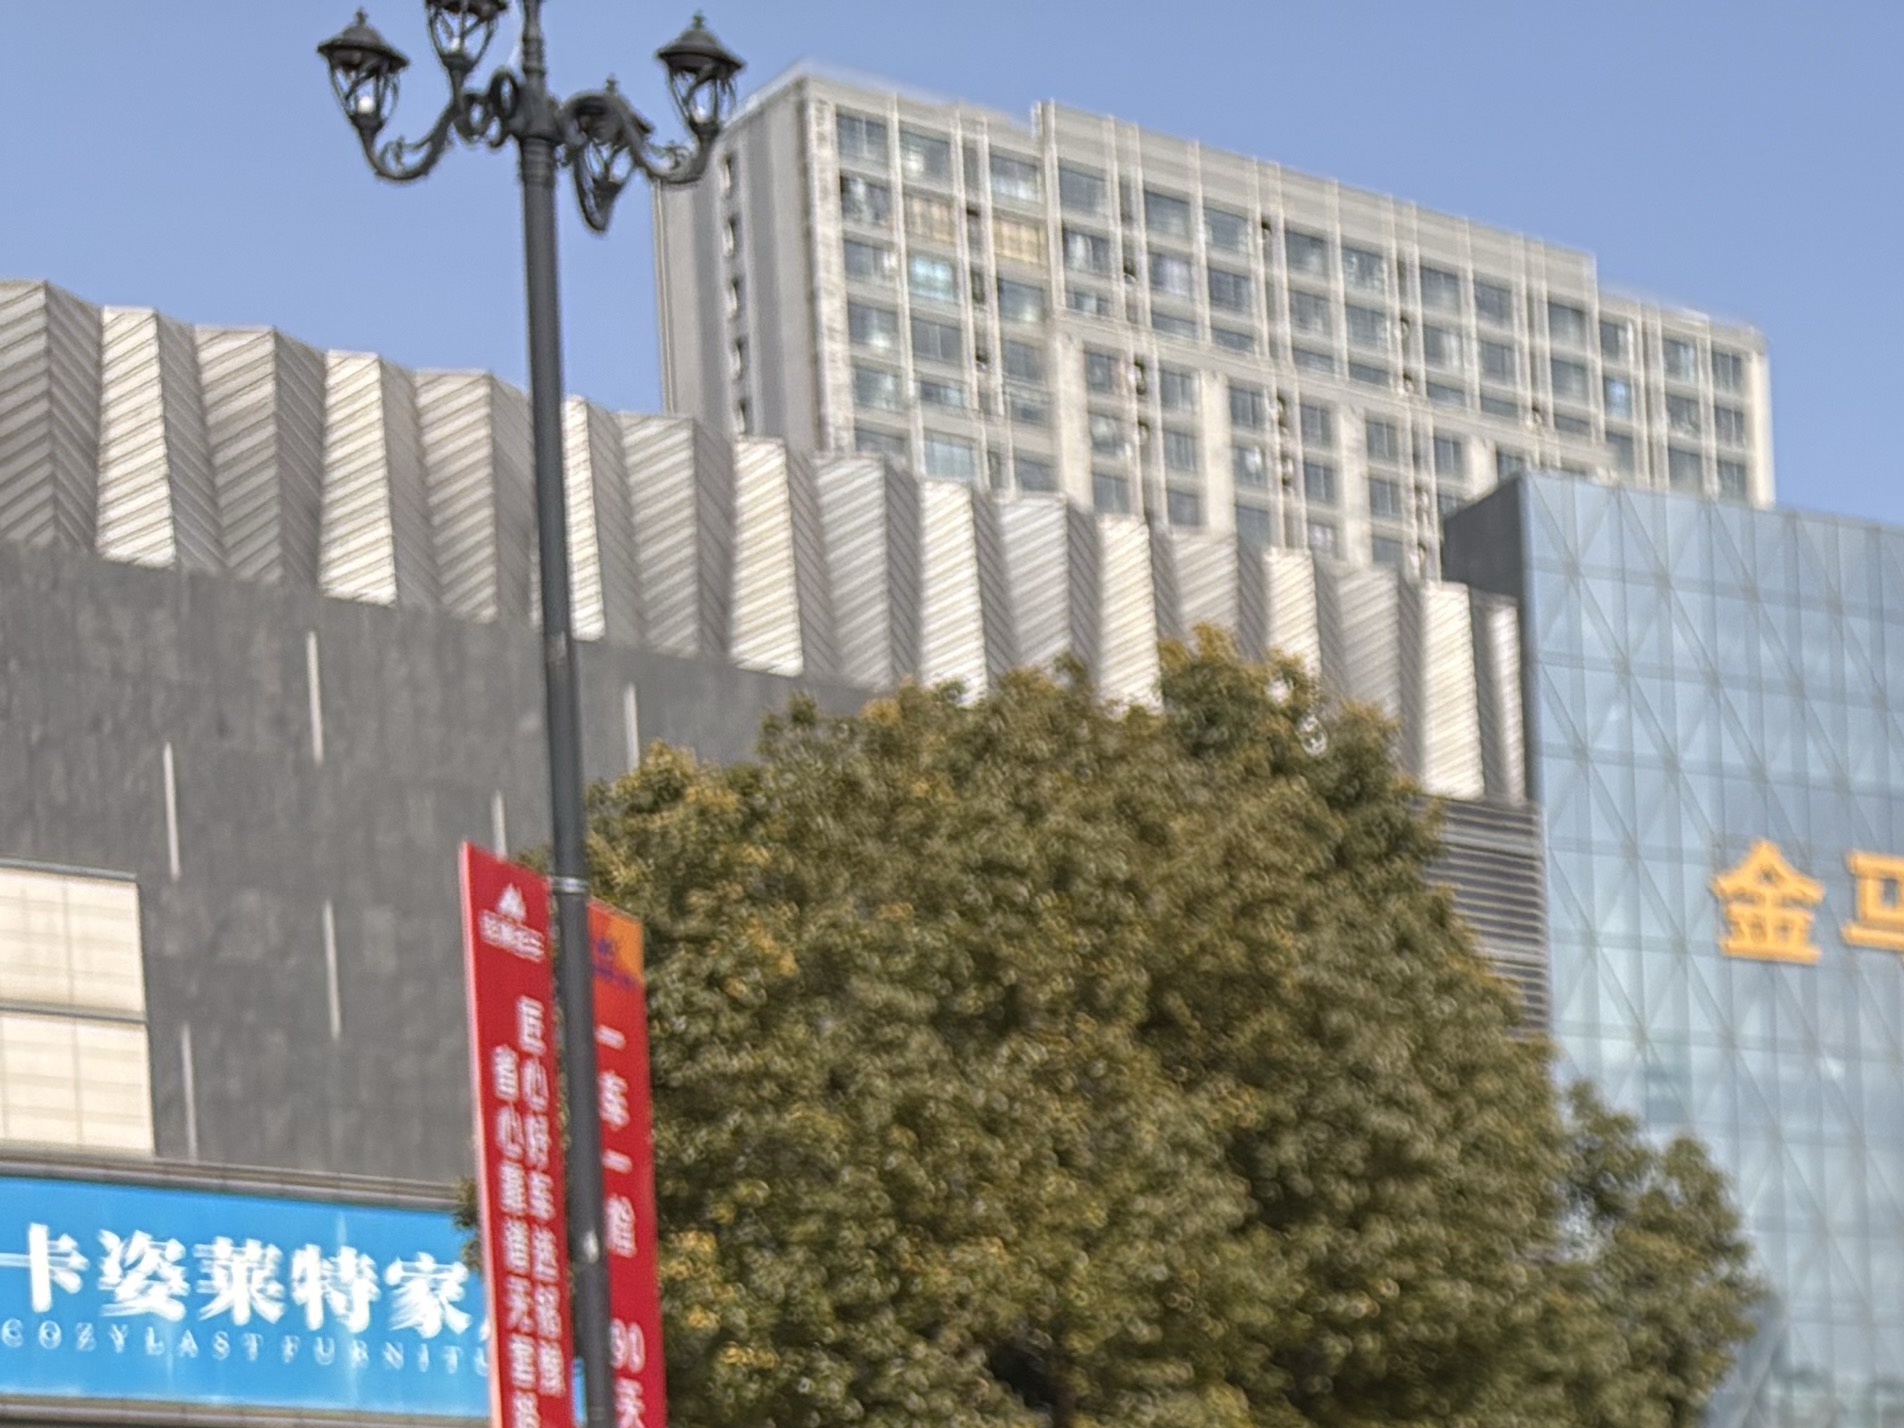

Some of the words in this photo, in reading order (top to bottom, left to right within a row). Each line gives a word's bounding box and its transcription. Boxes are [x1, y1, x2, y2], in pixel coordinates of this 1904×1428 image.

[0, 1221, 490, 1341] 卡姿莱特家
